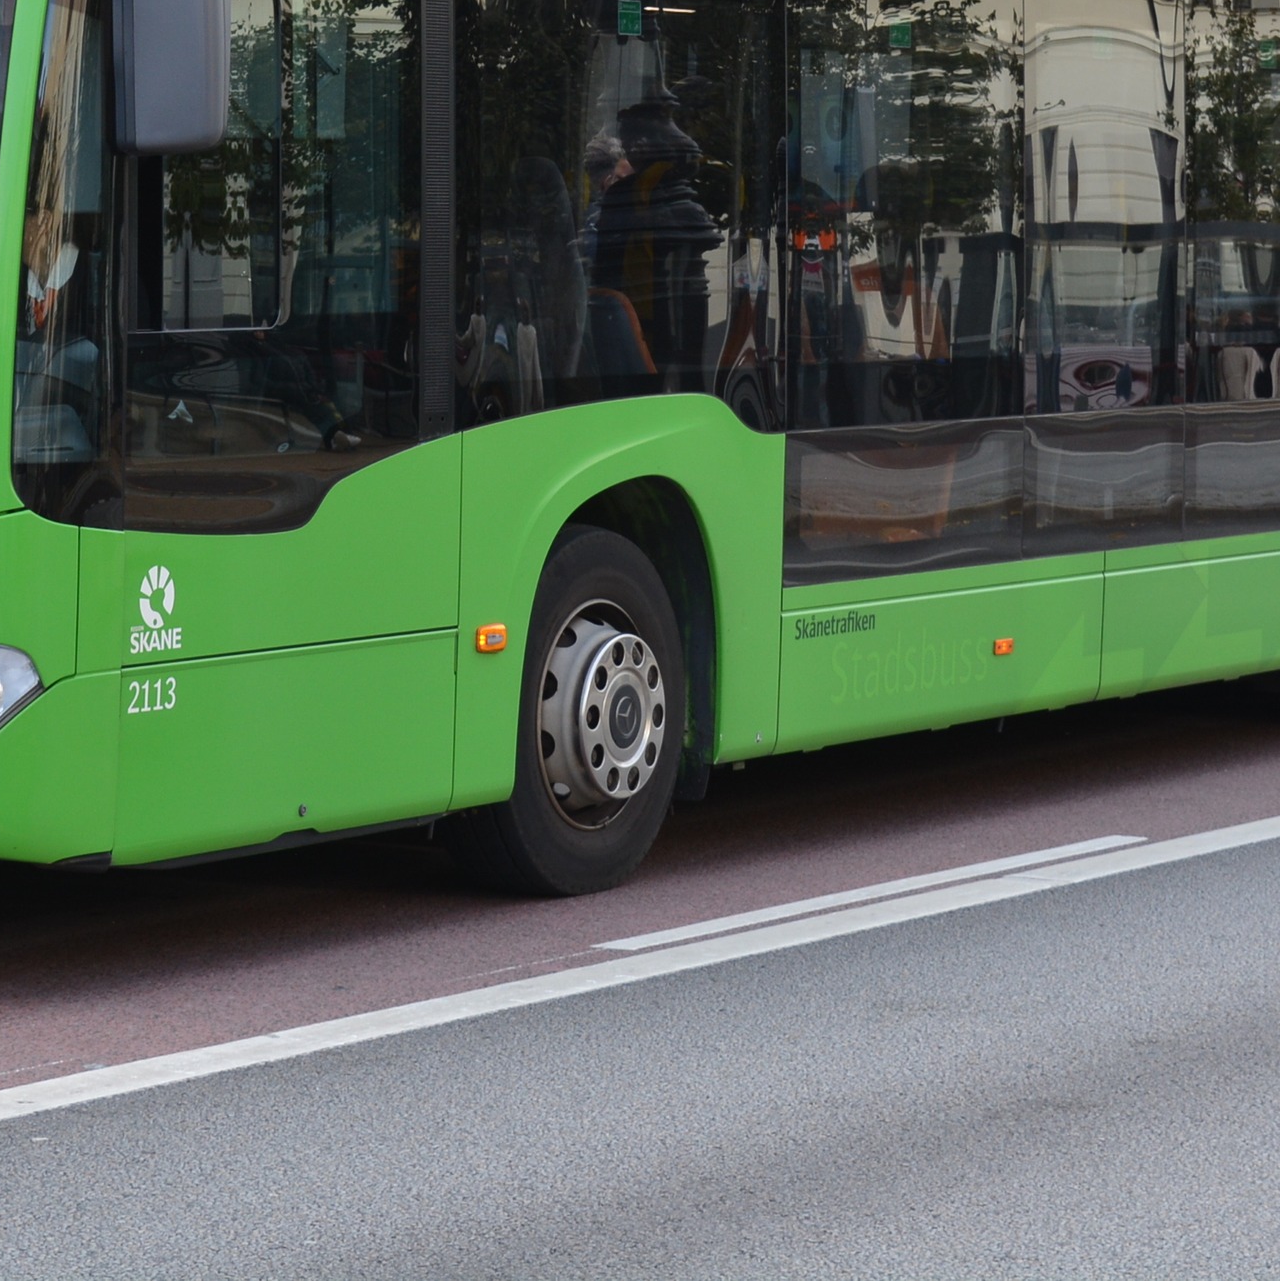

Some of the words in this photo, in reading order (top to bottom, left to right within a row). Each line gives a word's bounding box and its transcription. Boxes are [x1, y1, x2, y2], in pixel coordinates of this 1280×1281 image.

[794, 610, 876, 640] Skånetrafiken
[831, 626, 988, 704] Stadsbuss
[127, 676, 177, 714] 2113
